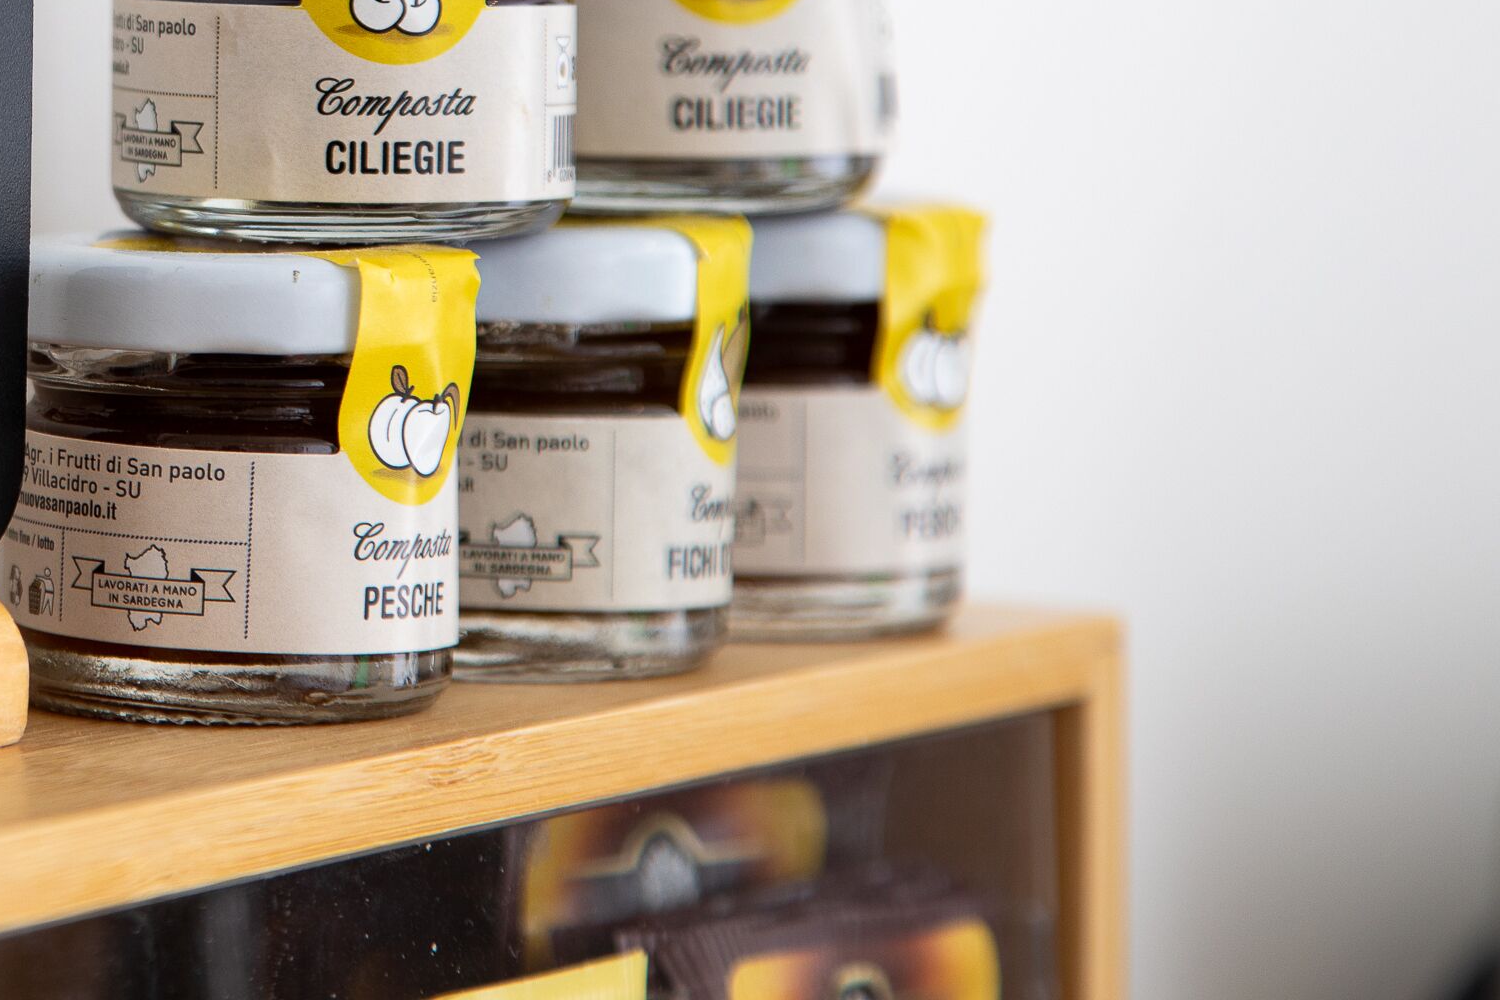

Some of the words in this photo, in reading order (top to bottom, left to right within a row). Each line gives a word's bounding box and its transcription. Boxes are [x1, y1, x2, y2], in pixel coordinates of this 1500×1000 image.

[136, 14, 155, 33] San
[158, 18, 197, 38] paolo
[131, 36, 145, 55] SU
[659, 35, 810, 92] Composta
[315, 77, 477, 136] Composta
[671, 97, 802, 130] CILIEGIE
[123, 134, 148, 146] LAVORATI
[155, 137, 177, 149] MANO
[134, 147, 168, 161] SARDEGNA
[325, 140, 466, 175] CILIEGIE
[469, 429, 487, 447] di
[493, 431, 530, 450] San
[536, 433, 590, 453] paolo
[57, 448, 101, 473] Frutti
[106, 455, 122, 474] di
[127, 458, 163, 478] San
[169, 463, 226, 483] paolo
[481, 453, 509, 472] SU
[32, 466, 98, 495] Villacidro
[116, 480, 142, 499] SU
[37, 534, 55, 551] lotto
[353, 522, 452, 580] Composta
[462, 549, 518, 561] LAVORATI
[530, 551, 566, 562] MANO
[666, 544, 718, 581] FICHI
[490, 563, 553, 576] SARDEGNA
[98, 579, 149, 594] LAVORATI
[151, 584, 160, 594] A
[162, 584, 198, 597] MANO
[108, 593, 119, 603] IN
[122, 594, 184, 609] SARDEGNA
[363, 581, 445, 621] PESCHE
